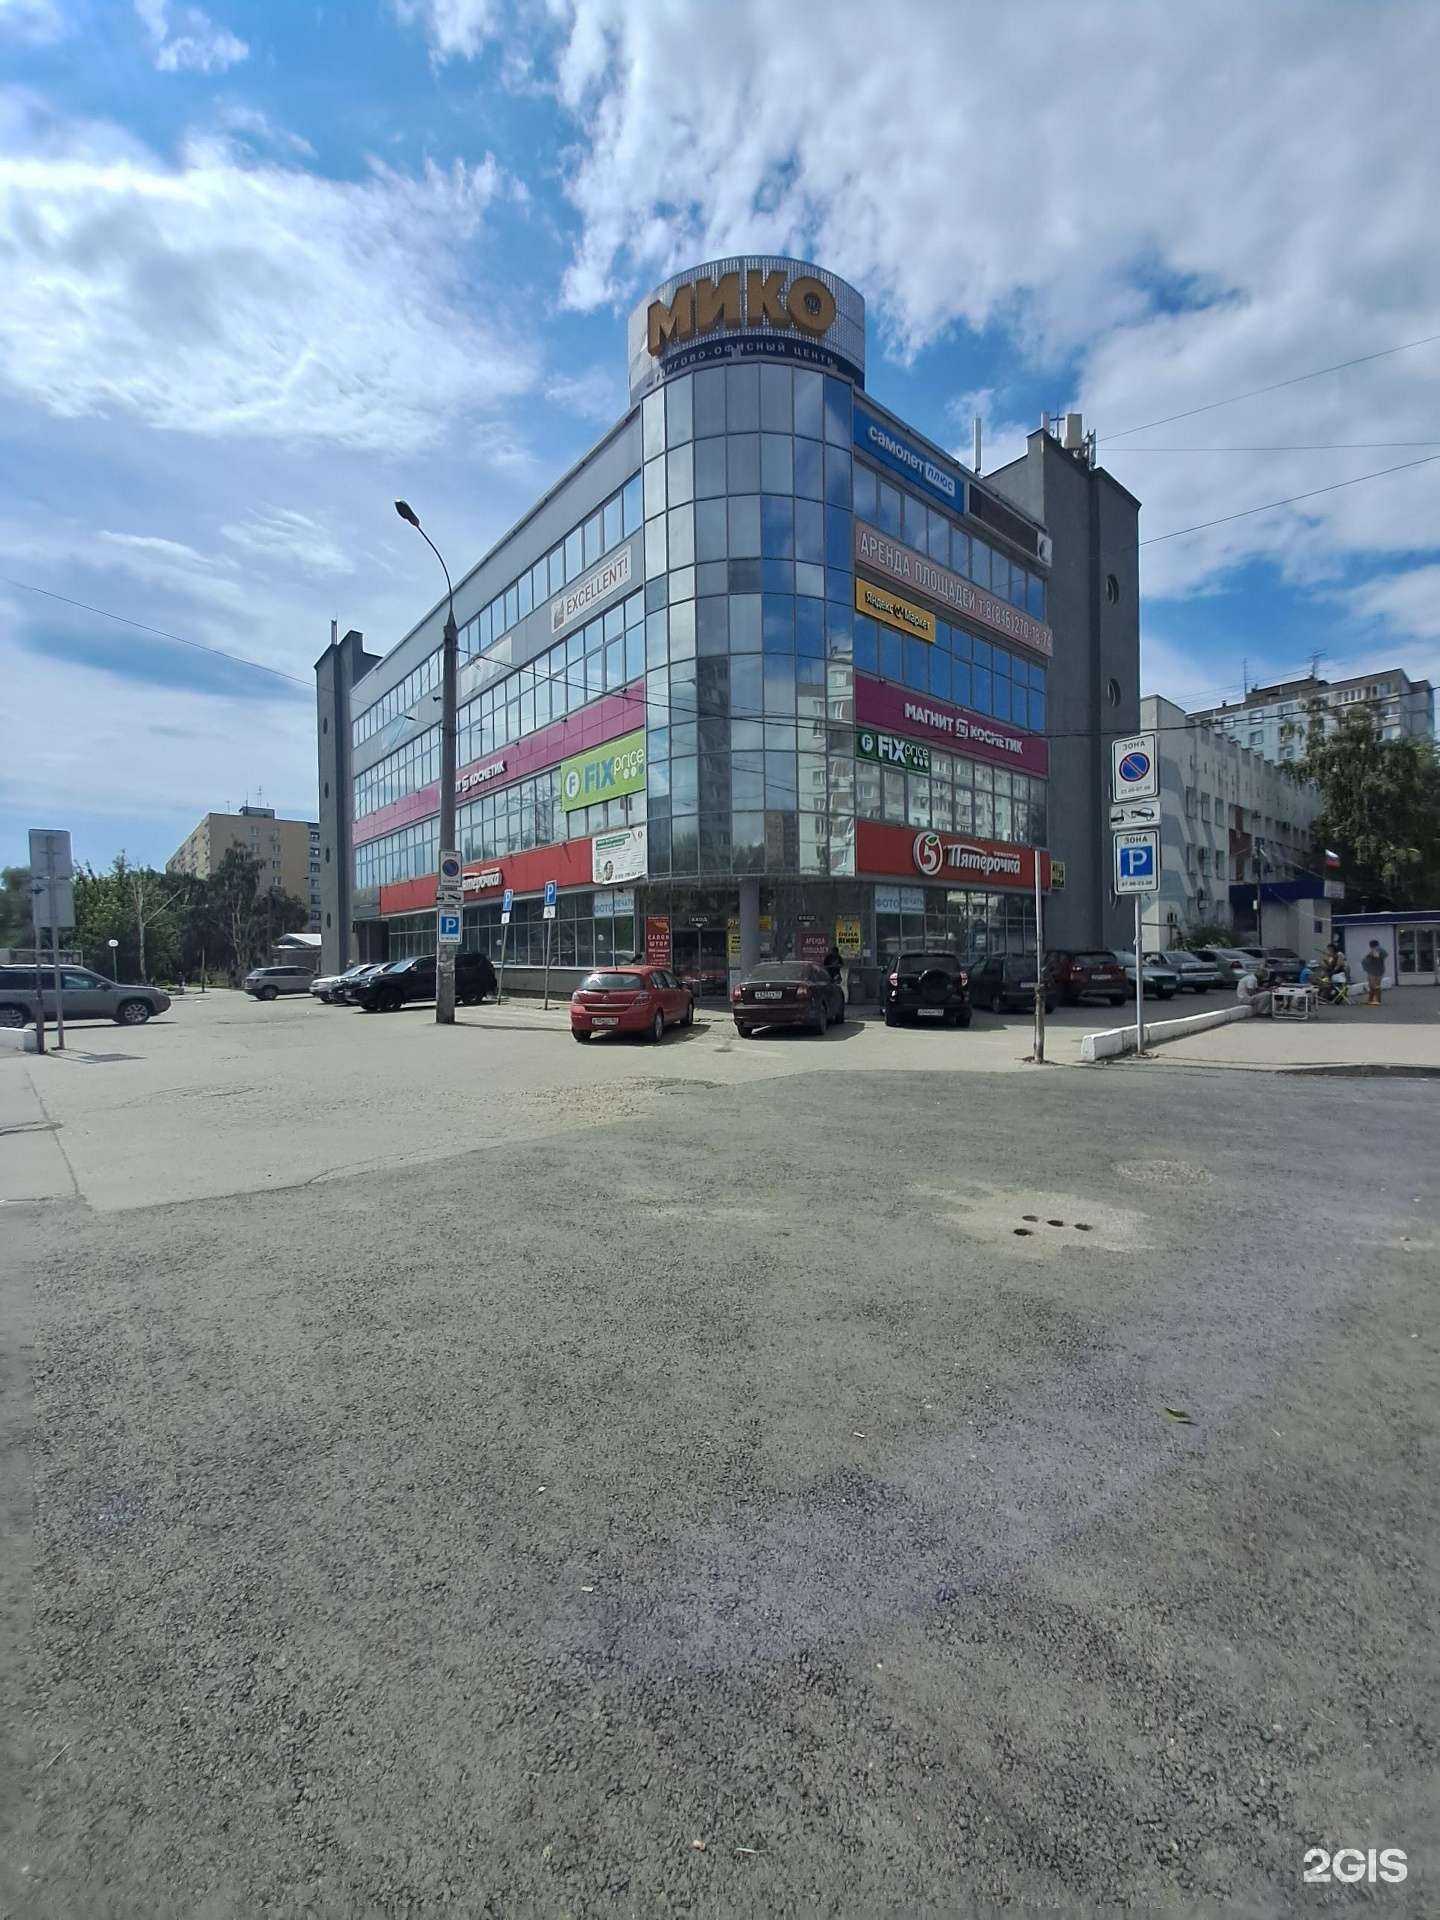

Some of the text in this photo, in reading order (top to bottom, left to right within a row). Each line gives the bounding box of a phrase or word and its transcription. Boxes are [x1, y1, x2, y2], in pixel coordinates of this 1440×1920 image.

[647, 269, 837, 358] МИКО
[794, 347, 834, 366] ЦЕНТР
[869, 425, 925, 474] самолет
[861, 533, 911, 577] АРЕНДА
[566, 556, 628, 616] EXCELLENT!
[904, 702, 1024, 754] МАГНИТ КОСМЕТИК
[1122, 741, 1146, 750] ЗОНА
[1124, 835, 1148, 844] ЗОНА
[944, 844, 1021, 876] Пятерочка
[1128, 849, 1148, 875] P
